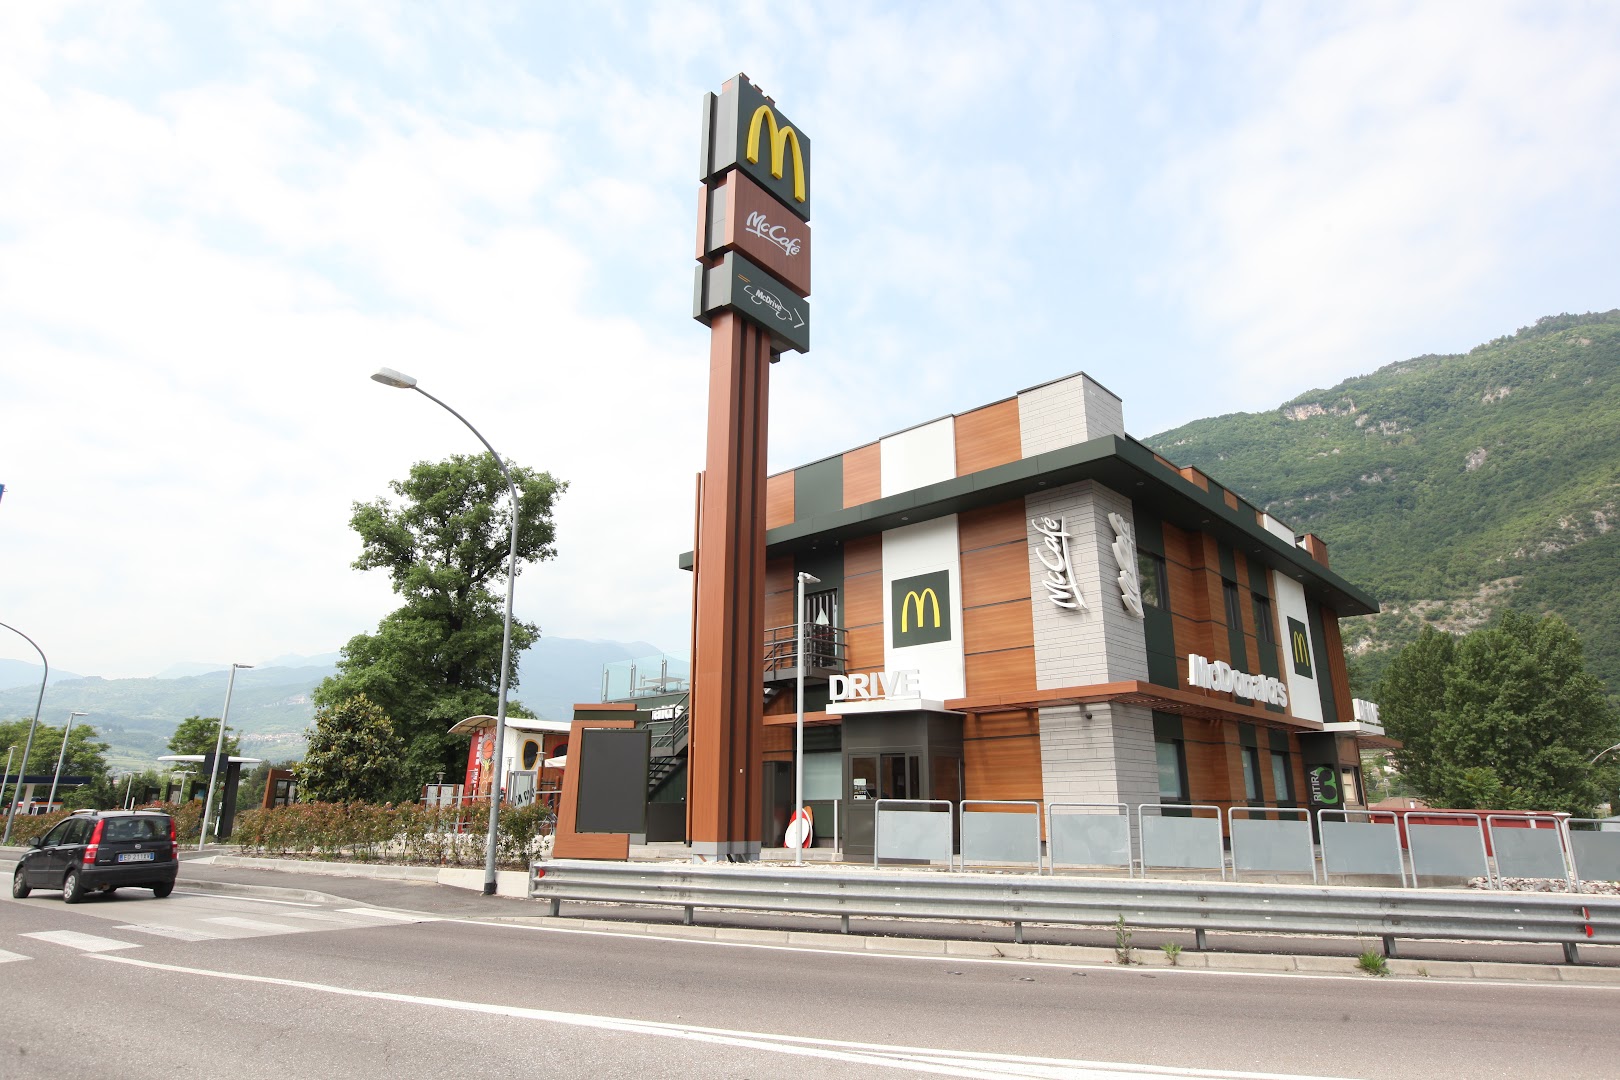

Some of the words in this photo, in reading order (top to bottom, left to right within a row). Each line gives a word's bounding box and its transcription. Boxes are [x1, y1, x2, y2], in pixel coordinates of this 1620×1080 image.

[745, 211, 801, 256] McCafé
[755, 289, 783, 313] McDrive
[1032, 515, 1084, 609] McCafé
[829, 669, 921, 702] DRIVE
[1310, 769, 1322, 802] RITIRA
